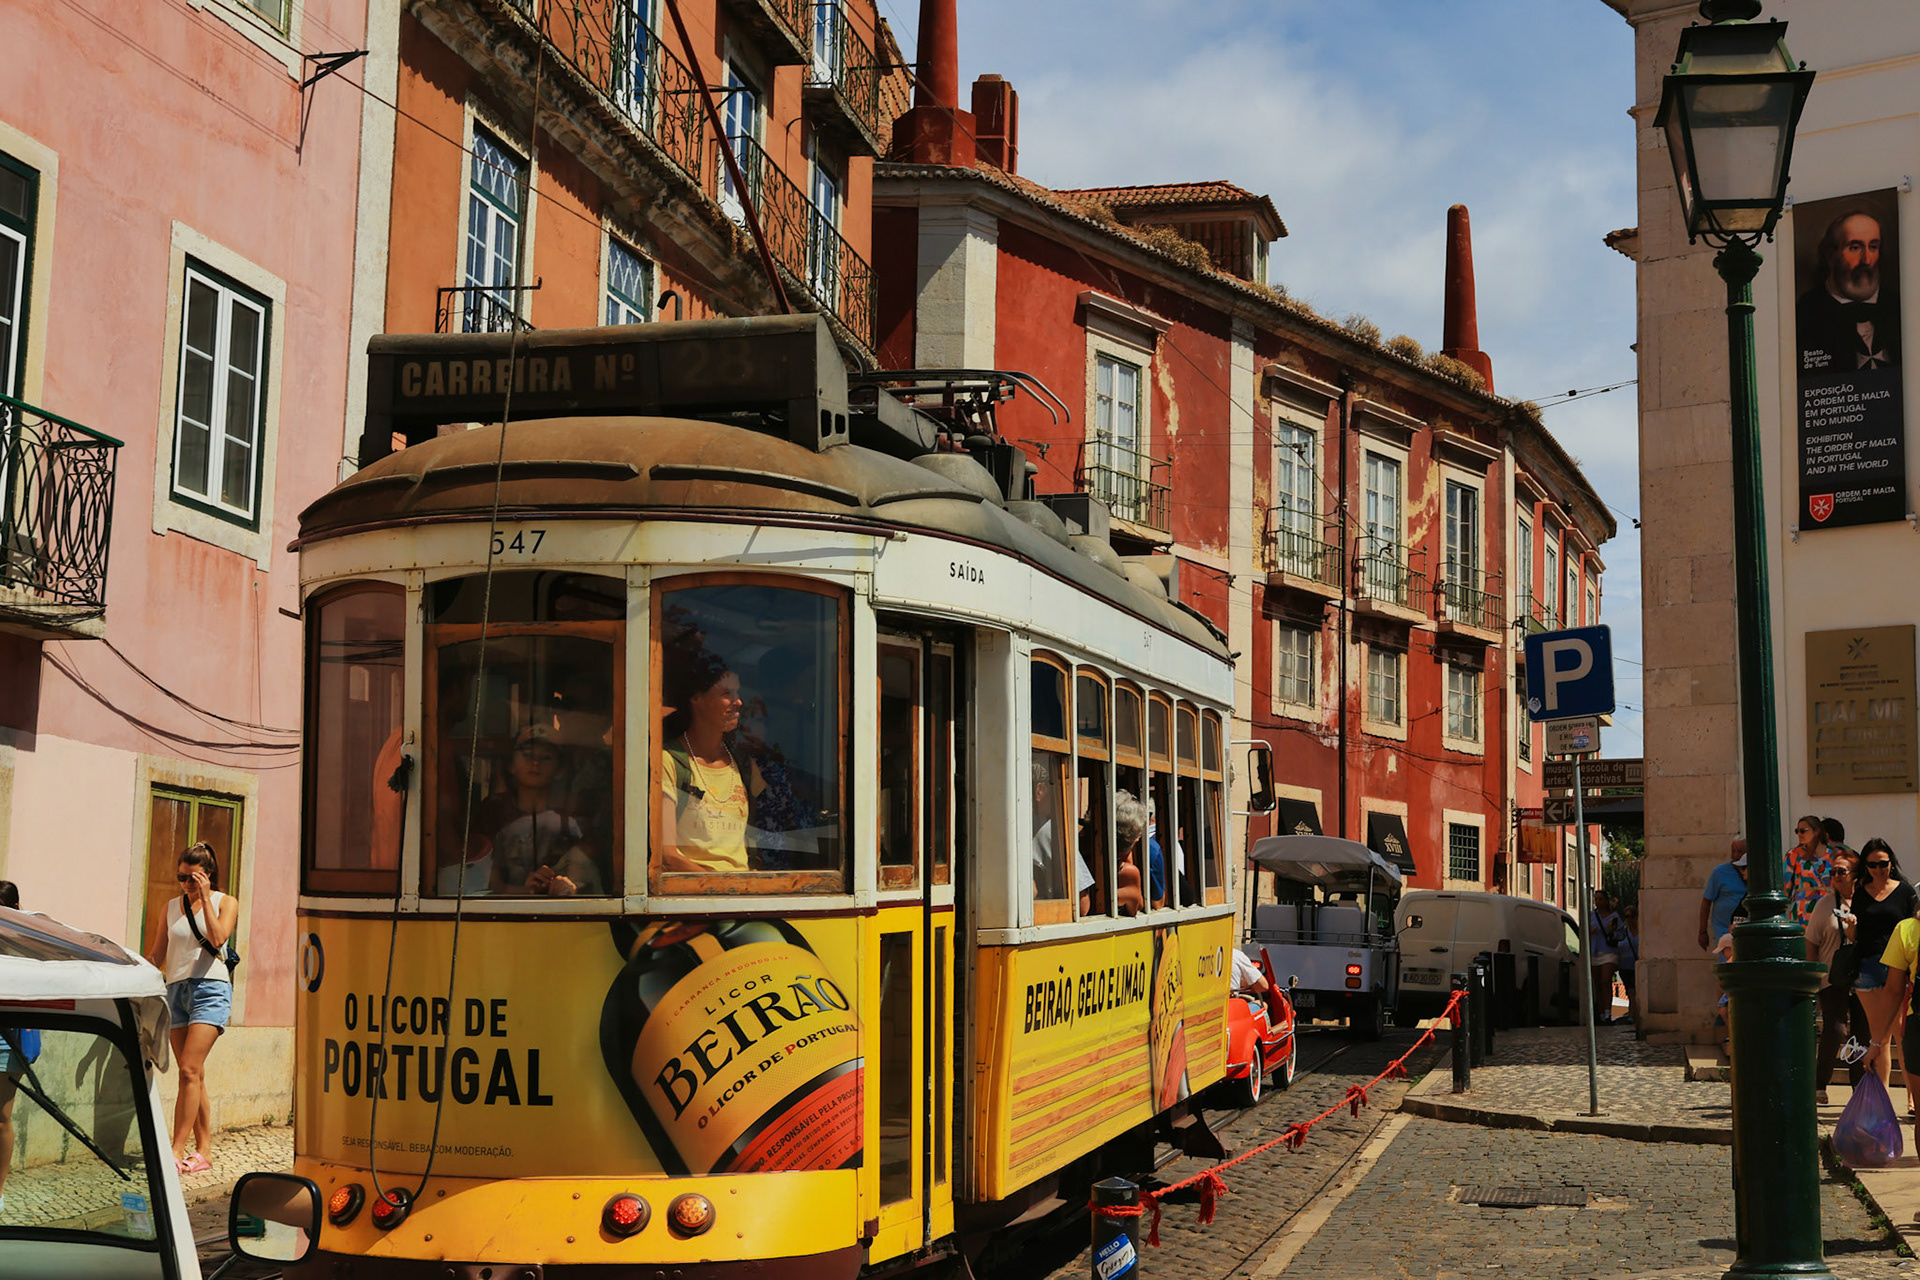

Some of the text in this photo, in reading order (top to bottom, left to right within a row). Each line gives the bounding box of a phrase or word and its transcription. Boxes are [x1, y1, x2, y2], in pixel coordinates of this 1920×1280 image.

[1804, 349, 1824, 357] Beato
[1804, 355, 1832, 363] Gerardo
[401, 355, 572, 398] CARREIRA
[1804, 384, 1854, 398] EXPOSIÇÃO
[1814, 396, 1845, 406] ORDEM
[1862, 390, 1890, 400] MALTA
[1805, 404, 1866, 418] EM PORTUGAL
[1813, 418, 1827, 426] NO
[1828, 414, 1864, 425] MUNDO
[1806, 432, 1853, 445] EXHIBITION
[1806, 446, 1822, 454] THE
[1824, 443, 1852, 453] ORDER
[1868, 438, 1897, 448] MALTA
[1806, 452, 1862, 466] IN PORTUGAL
[1806, 459, 1889, 476] AND IN THE WORLD
[1835, 486, 1896, 498] ORDEM DE MALTA
[491, 529, 547, 556] 547
[949, 560, 986, 586] SAÍDA
[1541, 637, 1594, 711] P
[1546, 762, 1624, 774] museu escola de
[1546, 776, 1566, 786] artes
[1384, 842, 1404, 854] XVIII
[674, 976, 722, 1018] CARRANCA
[724, 957, 770, 978] REDONDO
[704, 974, 774, 1017] LICOR
[1024, 951, 1147, 1034] BEIRÃO, GELO E LIMÃO
[344, 993, 508, 1038] O LICOR DE
[653, 974, 850, 1122] BEIRÃO
[323, 1040, 554, 1106] PORTUGAL
[698, 1023, 859, 1130] O LICOR DE PORTUGAL
[818, 1100, 838, 1119] PELA
[342, 1135, 514, 1158] SEJA RESONSÁVEL. BEBA COM MODERAÇÃO.
[1098, 1240, 1120, 1258] HELLO
